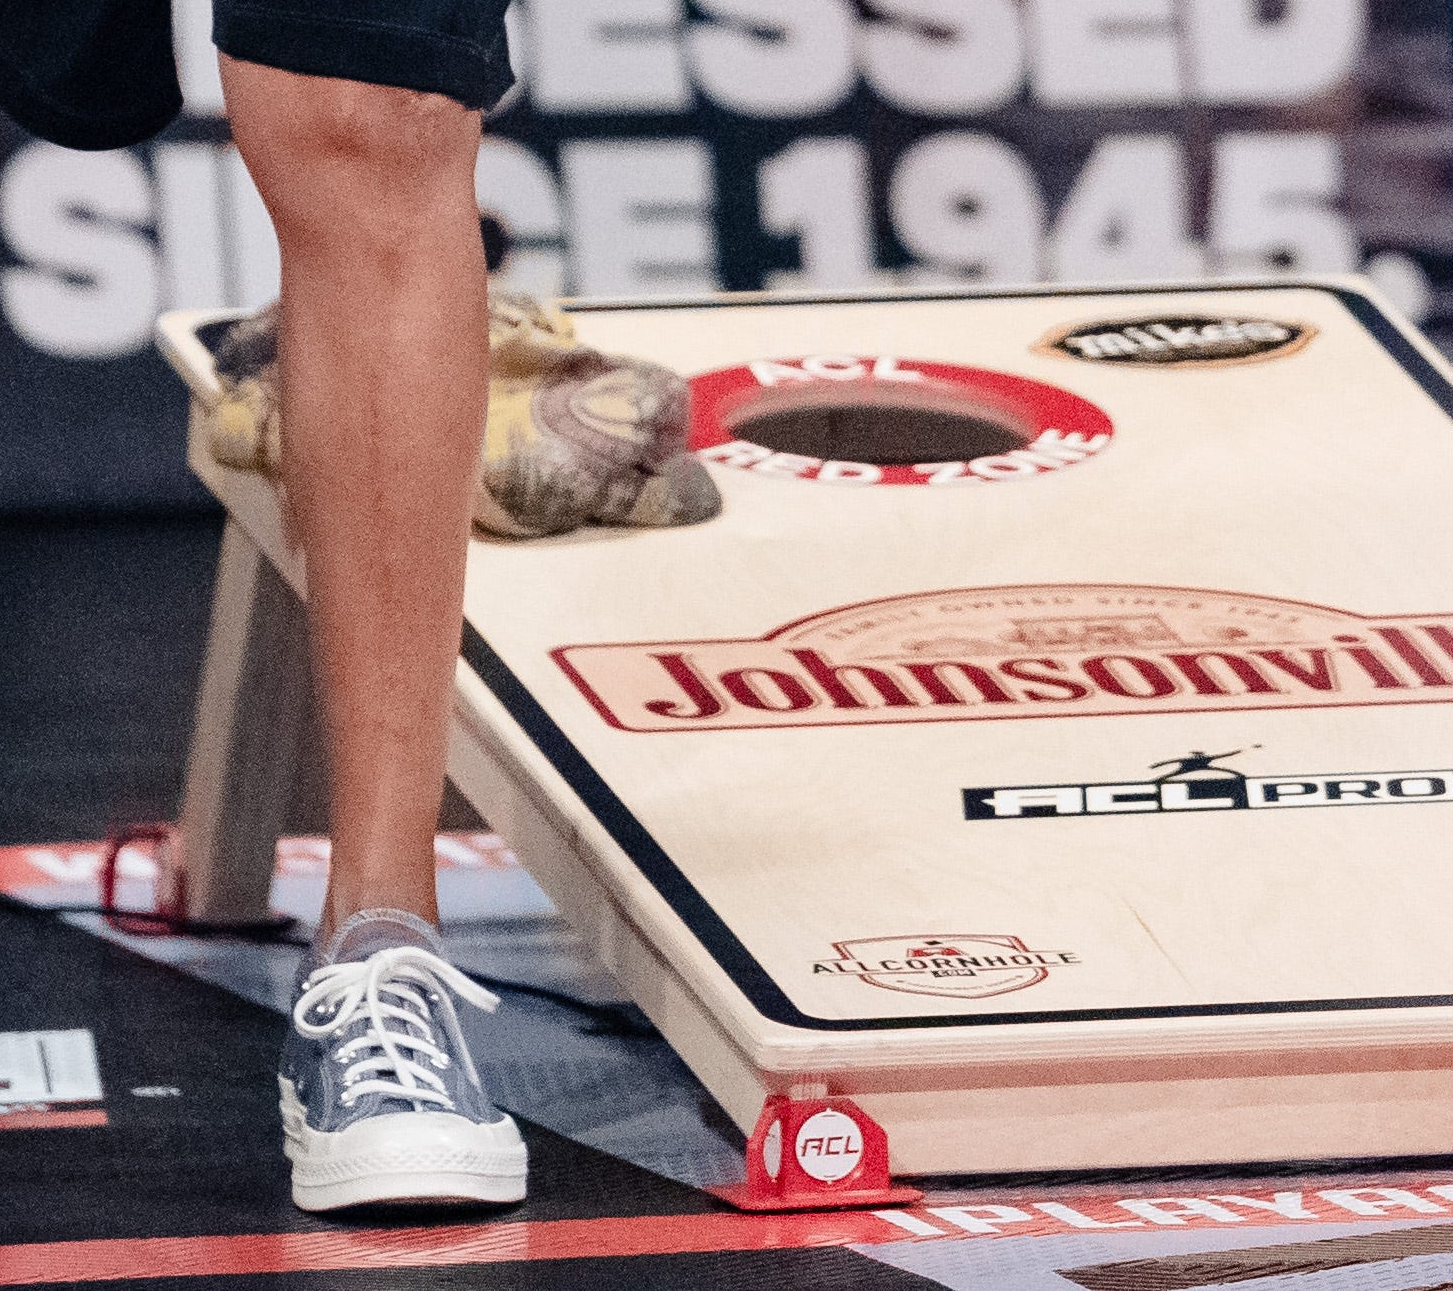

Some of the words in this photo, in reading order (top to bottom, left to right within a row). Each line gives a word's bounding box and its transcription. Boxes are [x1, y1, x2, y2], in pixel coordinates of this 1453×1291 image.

[748, 354, 925, 387] ACL
[696, 439, 882, 486] RED
[916, 428, 1112, 485] ZONE
[981, 781, 1236, 817] ACL
[1261, 776, 1448, 803] PRO
[811, 951, 1084, 976] ALLCORNHOLE
[799, 1134, 860, 1158] ACL
